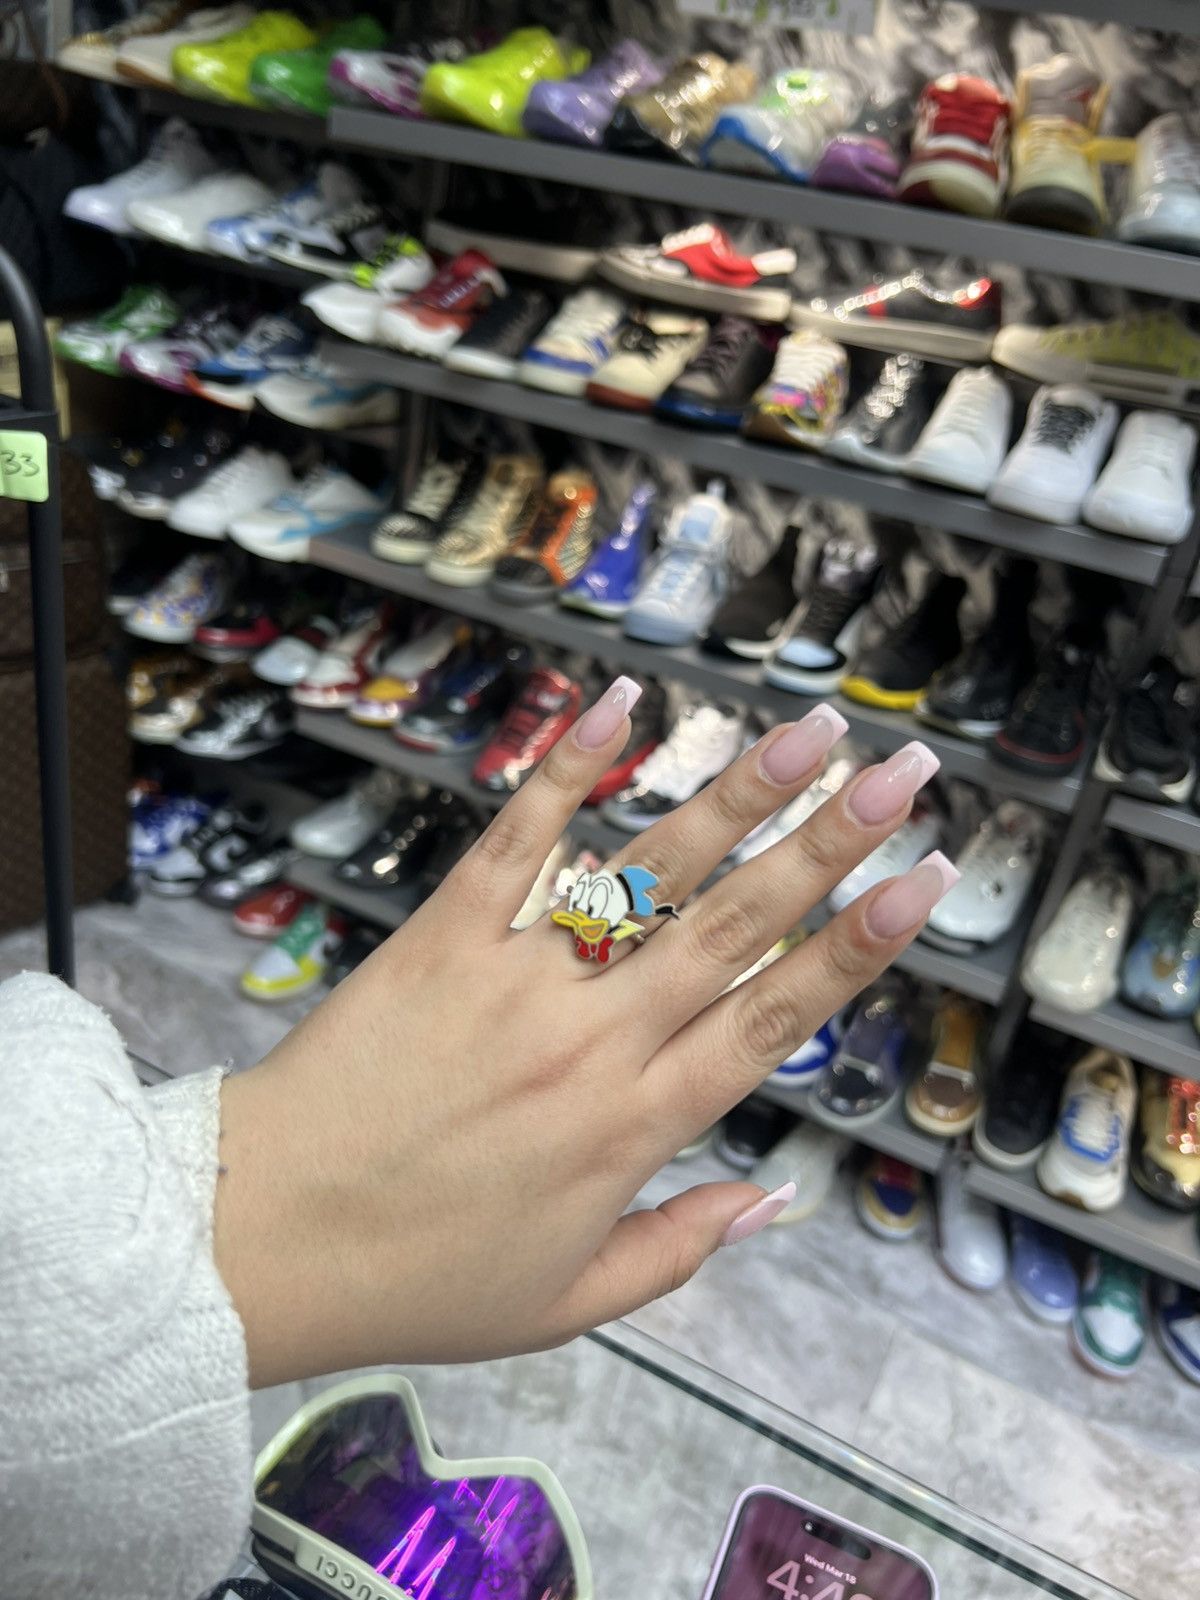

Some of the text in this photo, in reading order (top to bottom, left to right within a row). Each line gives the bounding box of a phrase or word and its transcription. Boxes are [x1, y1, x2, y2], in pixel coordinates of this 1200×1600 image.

[316, 1556, 389, 1600] UCCI
[804, 1553, 826, 1570] Wed
[824, 1563, 844, 1578] Mar
